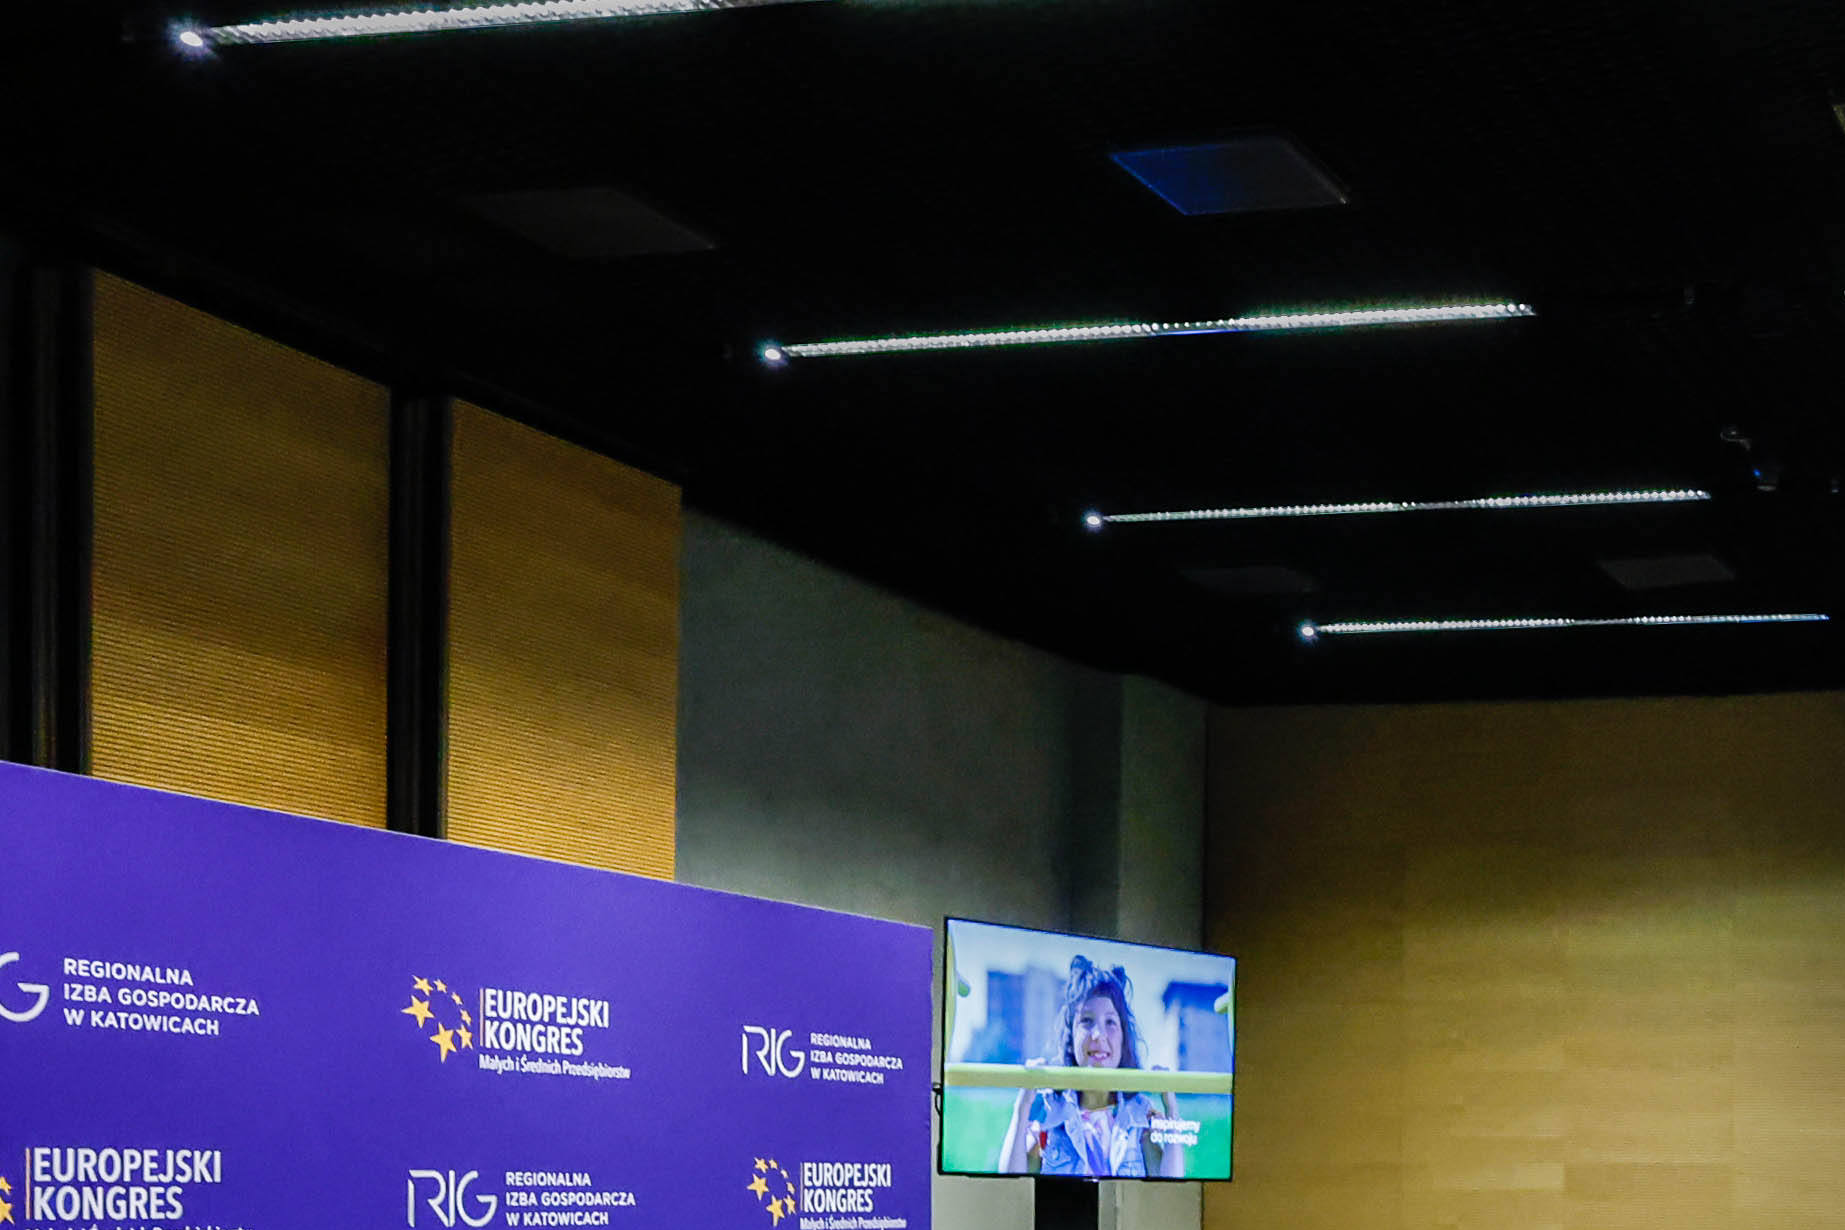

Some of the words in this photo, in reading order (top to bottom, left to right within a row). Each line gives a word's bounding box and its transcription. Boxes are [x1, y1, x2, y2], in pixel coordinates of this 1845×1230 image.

[64, 958, 194, 986] REGIONALNA
[64, 983, 112, 1003] IZBA
[118, 988, 260, 1015] GOSPODARCZA
[485, 988, 609, 1028] EUROPEJSKI
[64, 1008, 84, 1025] W
[91, 1011, 219, 1035] KATOWICACH
[485, 1020, 583, 1056] KONGRES
[742, 1025, 806, 1078] RIG
[810, 1032, 871, 1050] REGIONALNA
[810, 1050, 833, 1063] IZBA
[835, 1052, 903, 1070] GOSPODARCZA
[810, 1067, 821, 1080] W
[822, 1067, 884, 1084] KATOWICACH
[33, 1148, 222, 1183] EUROPEJSKI
[506, 1171, 592, 1186] REGIONALNA
[803, 1162, 892, 1187] EUROPEJSKI
[33, 1186, 183, 1220] KONGRES
[408, 1170, 498, 1228] RIG
[506, 1192, 537, 1206] IZBA
[541, 1192, 636, 1206] GOSPODARCZA
[803, 1188, 873, 1213] KONGRES
[506, 1212, 520, 1226] W
[523, 1211, 609, 1226] KATOWICACH
